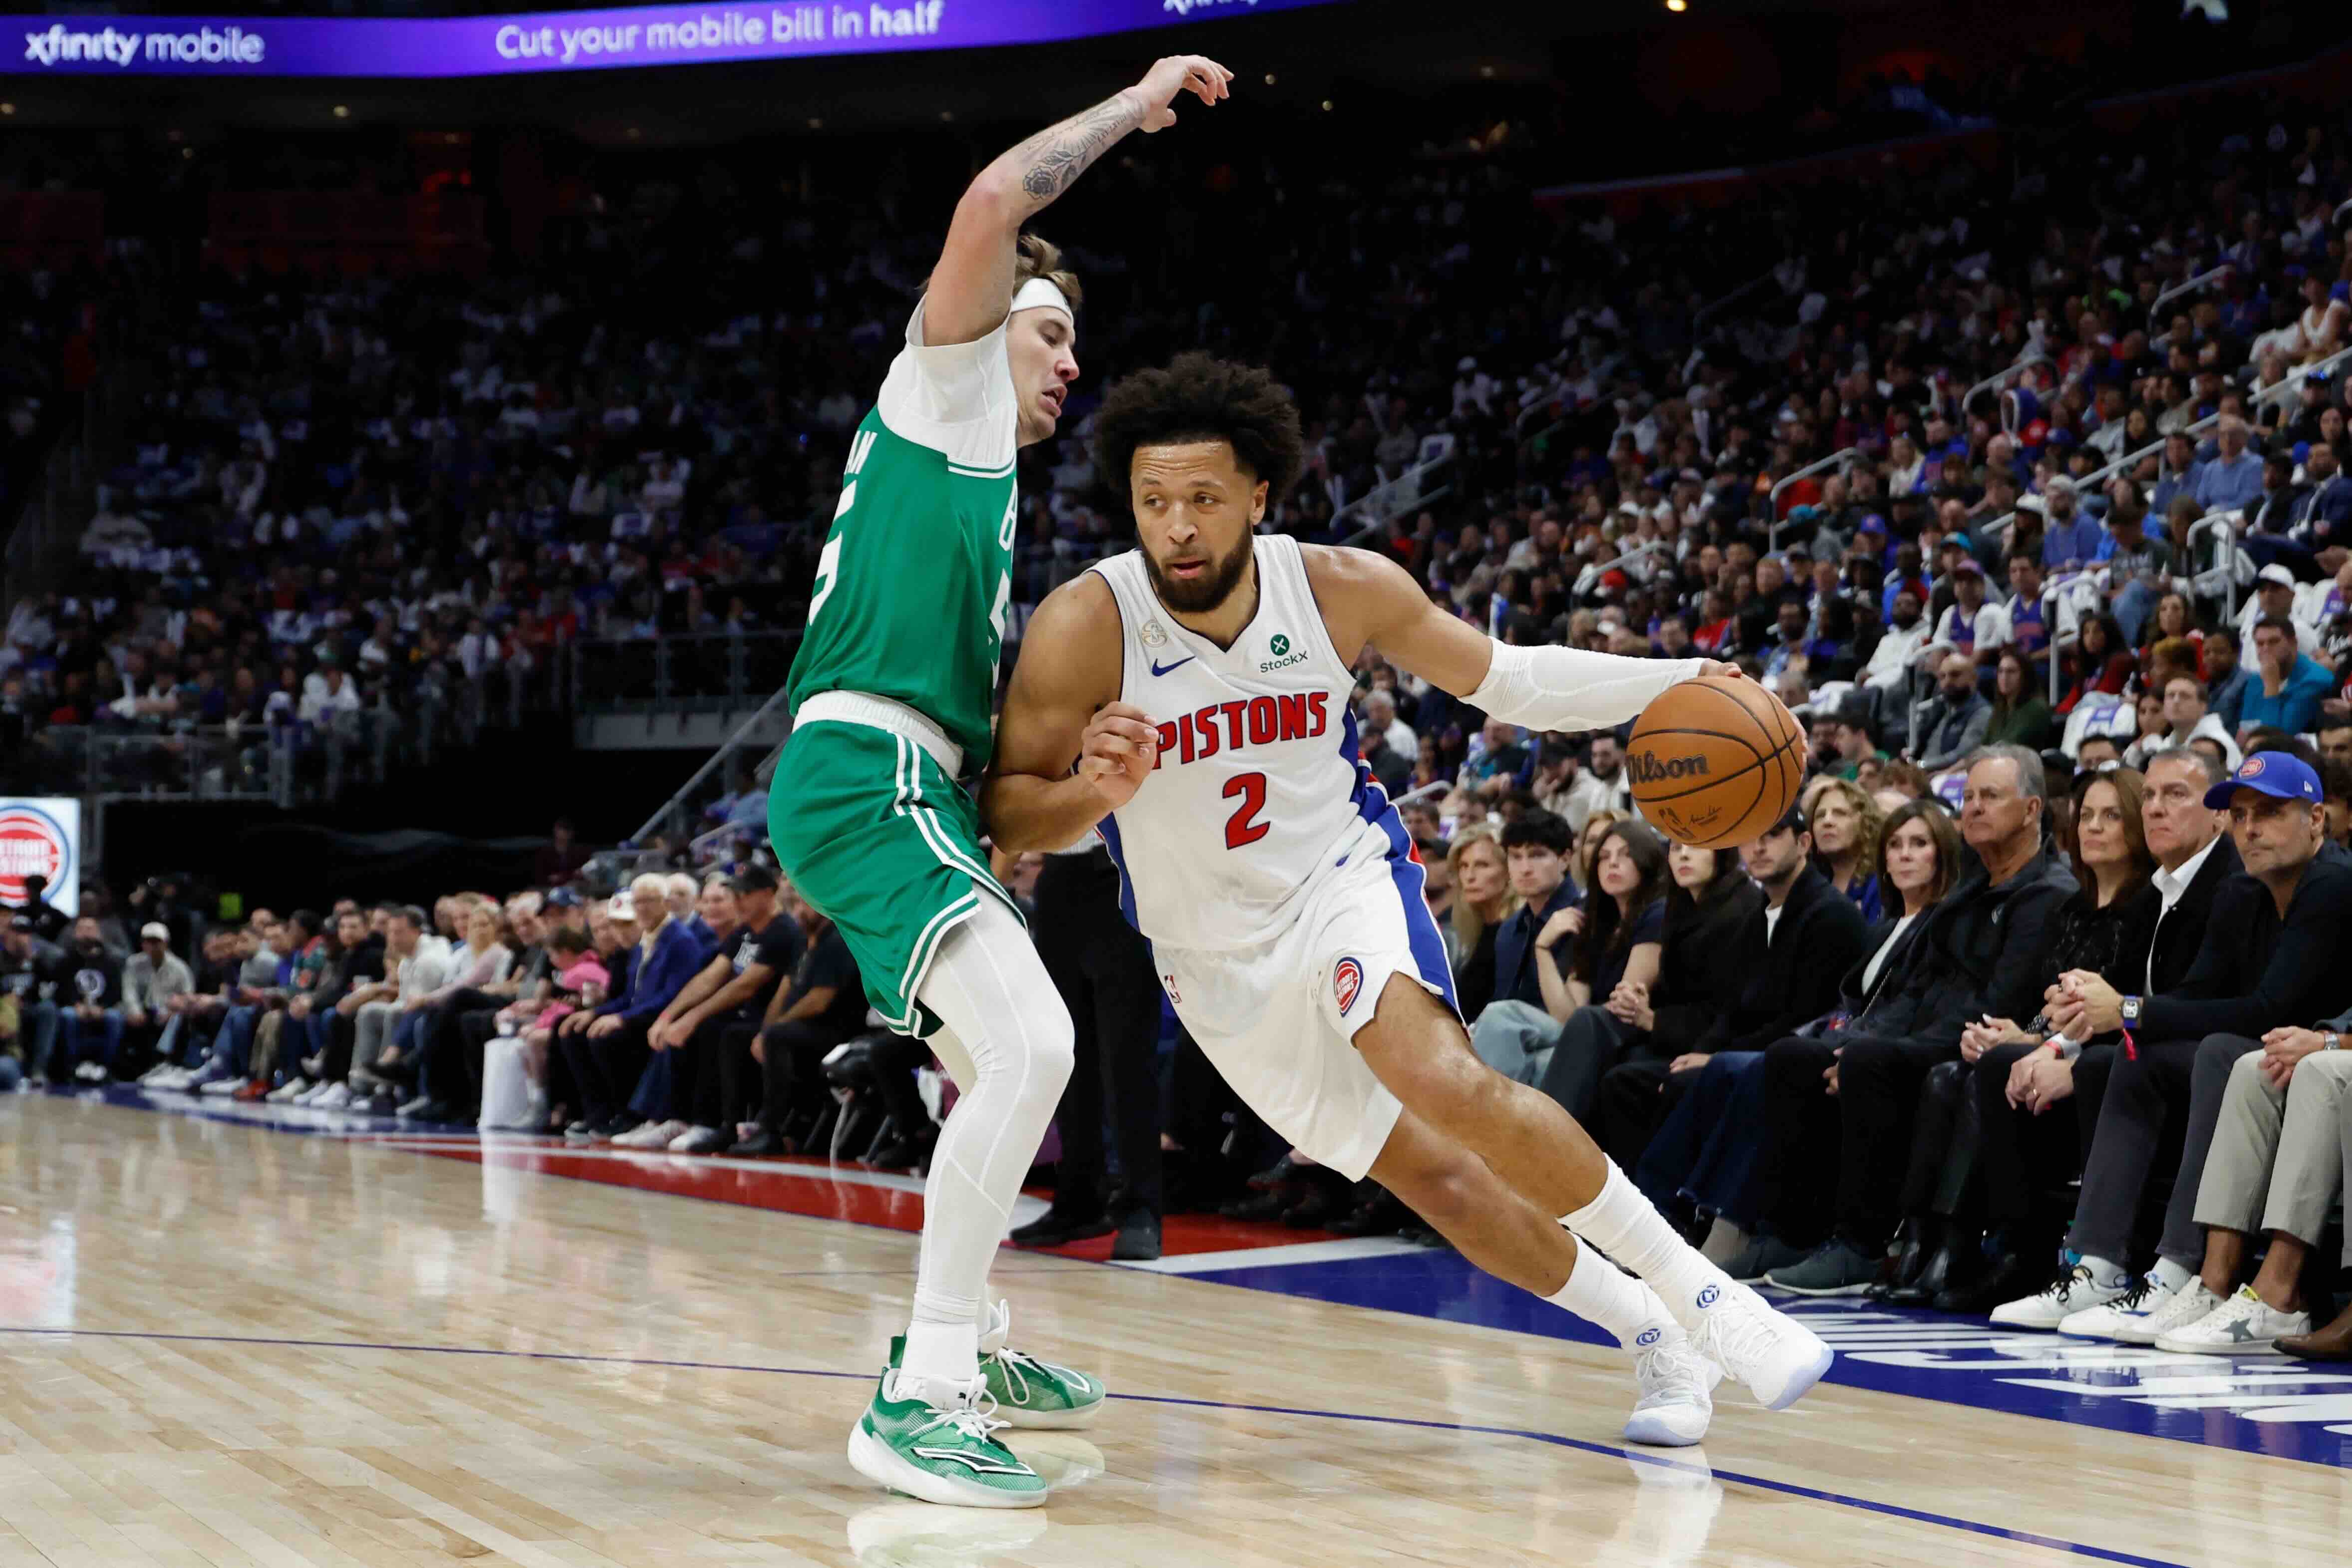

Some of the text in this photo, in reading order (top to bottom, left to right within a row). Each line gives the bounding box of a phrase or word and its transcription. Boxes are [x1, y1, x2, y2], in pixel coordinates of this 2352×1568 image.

[25, 24, 266, 66] xfinity mobile
[496, 0, 945, 64] Cut your mobile bill in half
[1259, 650, 1308, 673] StockX
[1152, 692, 1329, 770] PISTONS
[1222, 771, 1271, 851] 2
